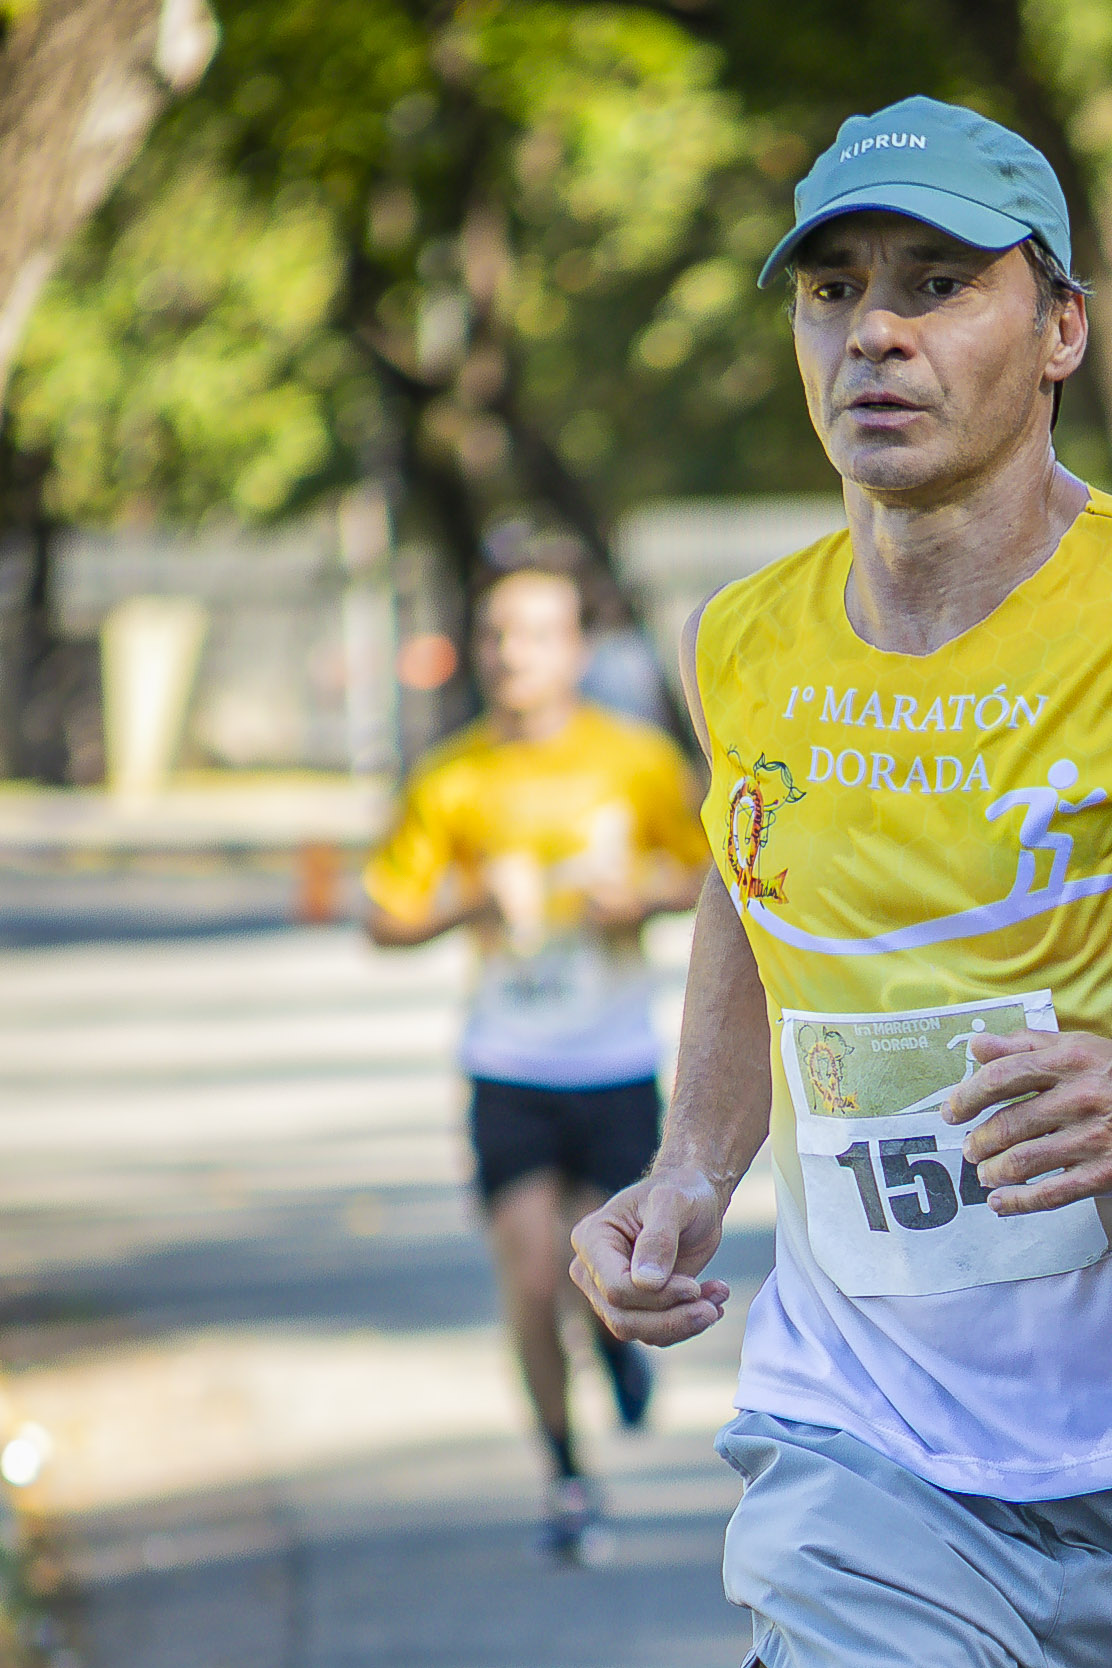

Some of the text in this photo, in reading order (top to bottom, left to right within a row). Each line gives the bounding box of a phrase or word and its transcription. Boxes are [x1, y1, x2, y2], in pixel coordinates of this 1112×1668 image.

[839, 132, 927, 163] KIPRUN
[819, 684, 1049, 732] MARATÓN
[806, 746, 991, 794] DORADA
[871, 1036, 929, 1053] DORADA
